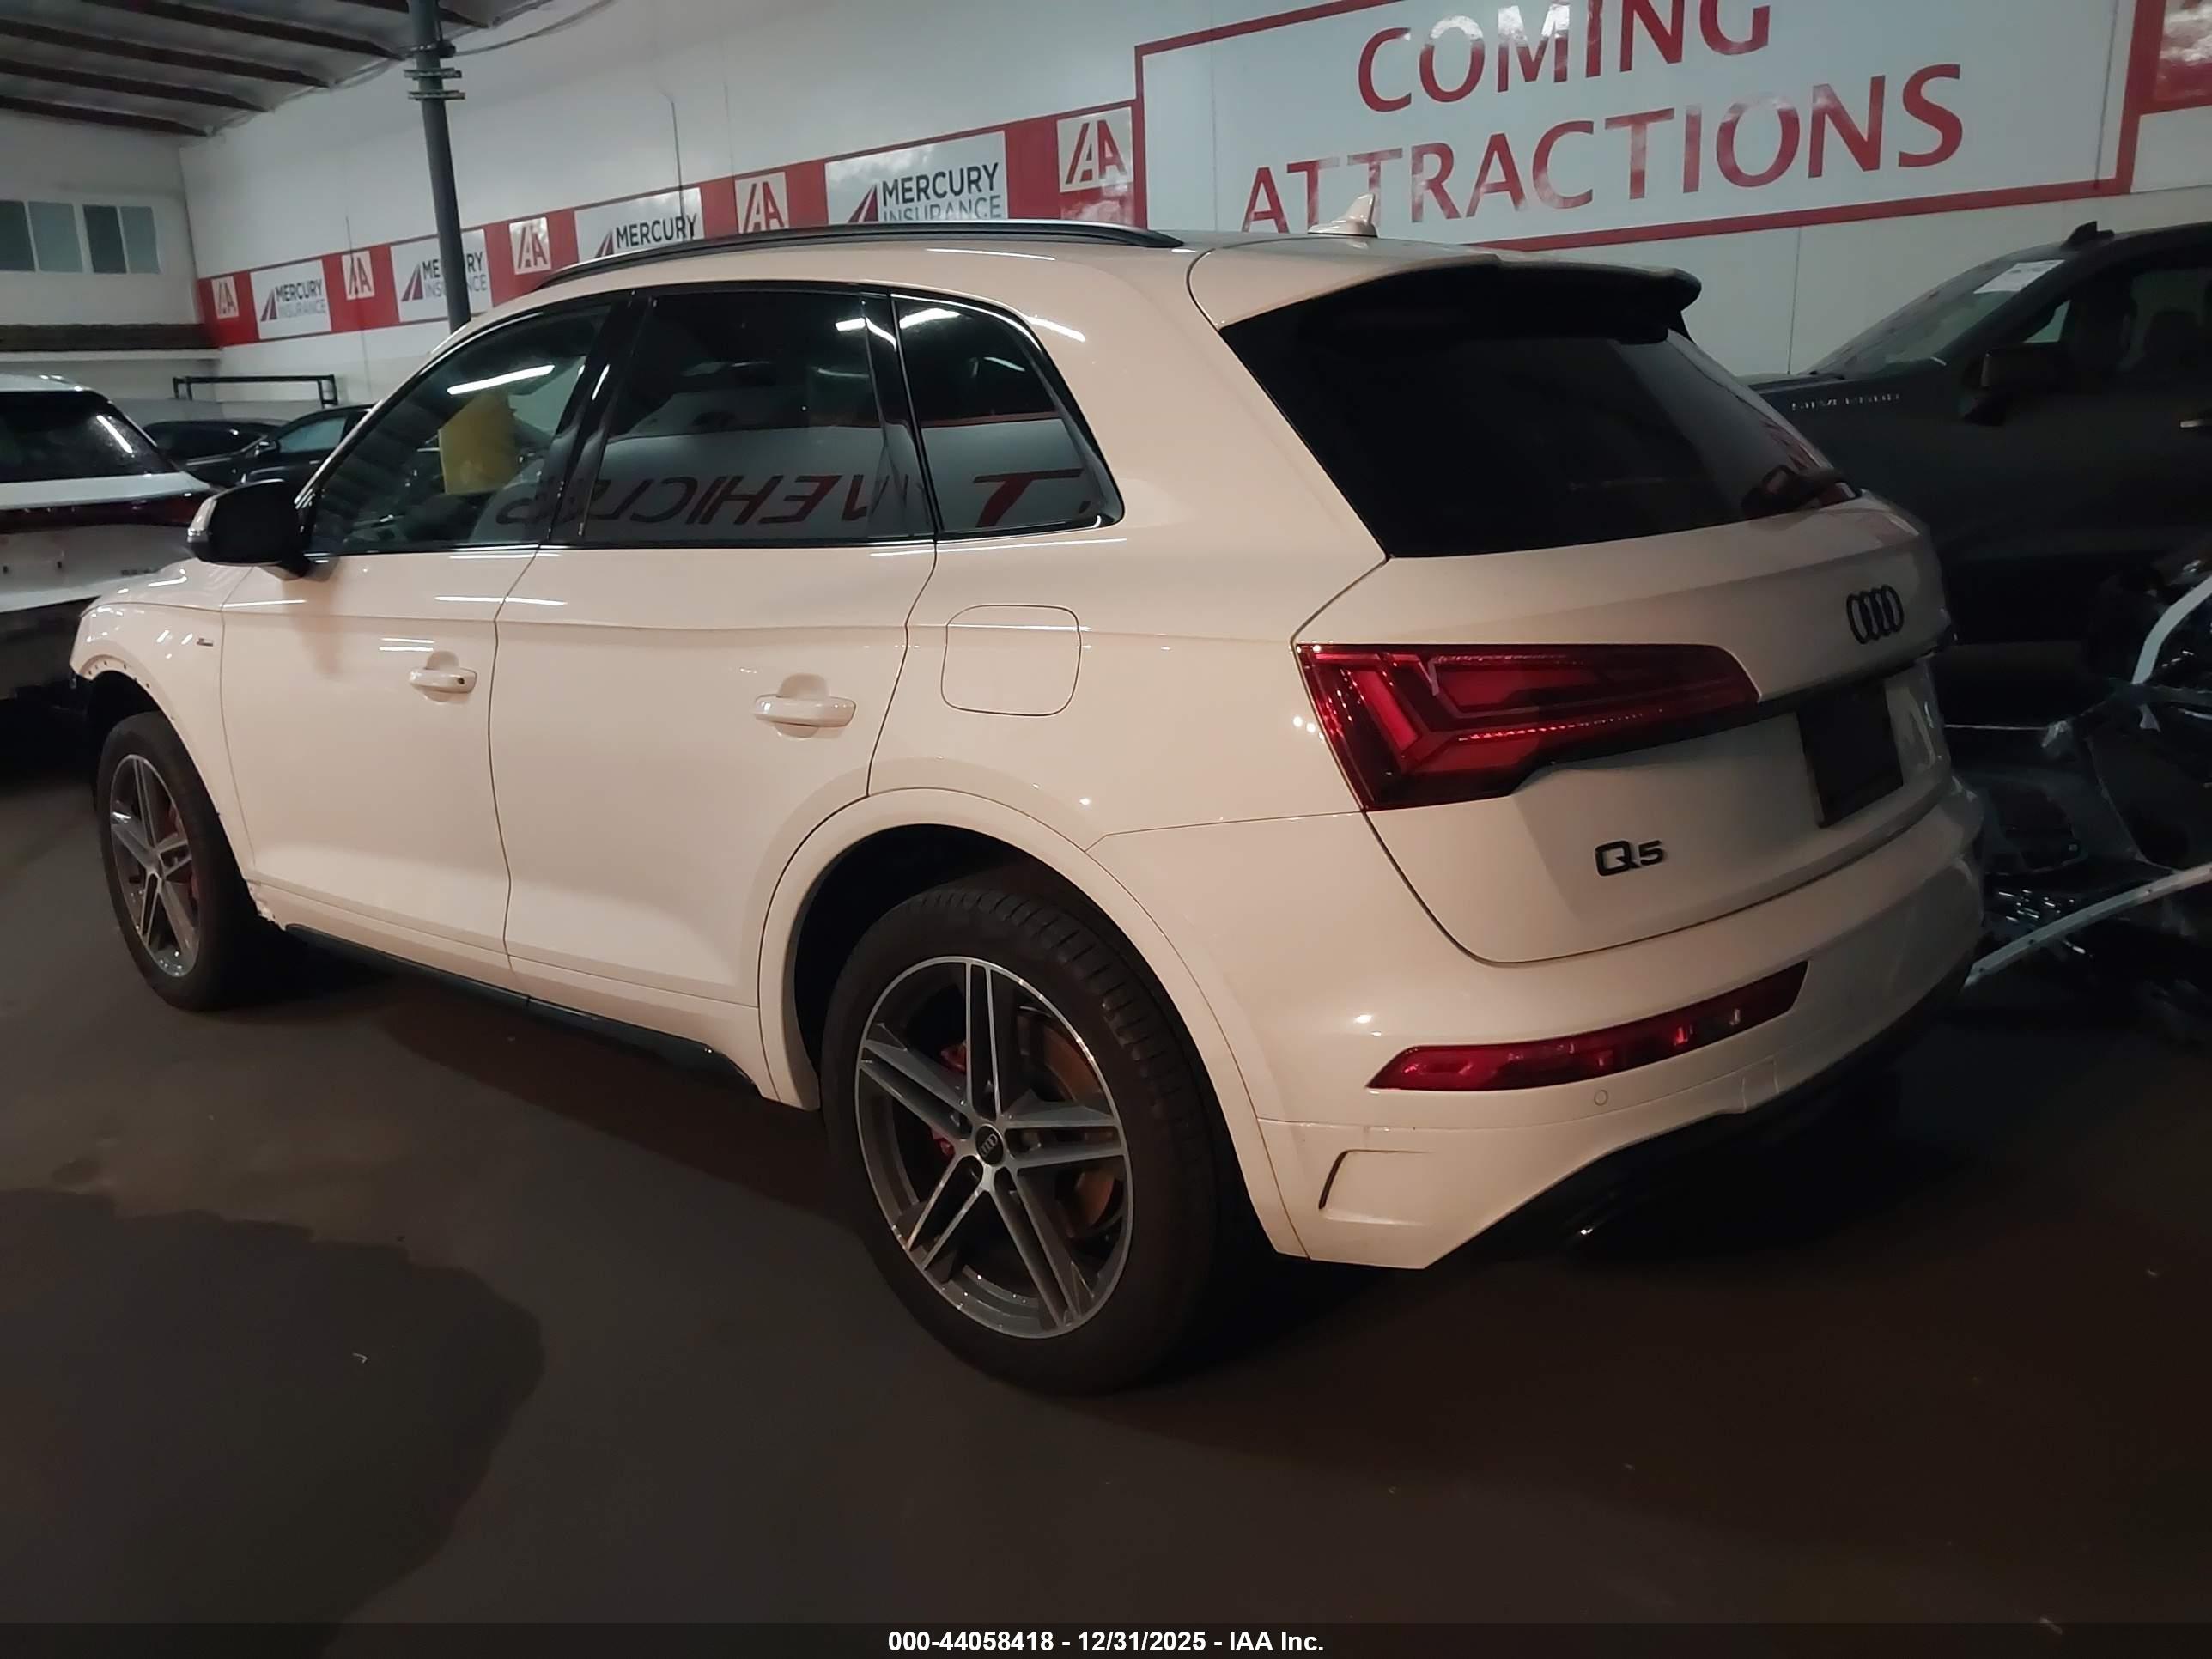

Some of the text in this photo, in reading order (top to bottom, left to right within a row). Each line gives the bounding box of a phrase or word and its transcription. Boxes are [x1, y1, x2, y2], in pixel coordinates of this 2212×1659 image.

[1358, 0, 1770, 112] COMING
[1242, 64, 1962, 234] ATTRACTIONS
[882, 162, 999, 207] MERCURY
[616, 213, 697, 249] MERCURY
[422, 252, 483, 280] MERY
[275, 279, 323, 303] MERCURY
[423, 274, 487, 298] INSNCE
[1595, 840, 1663, 877] Q5
